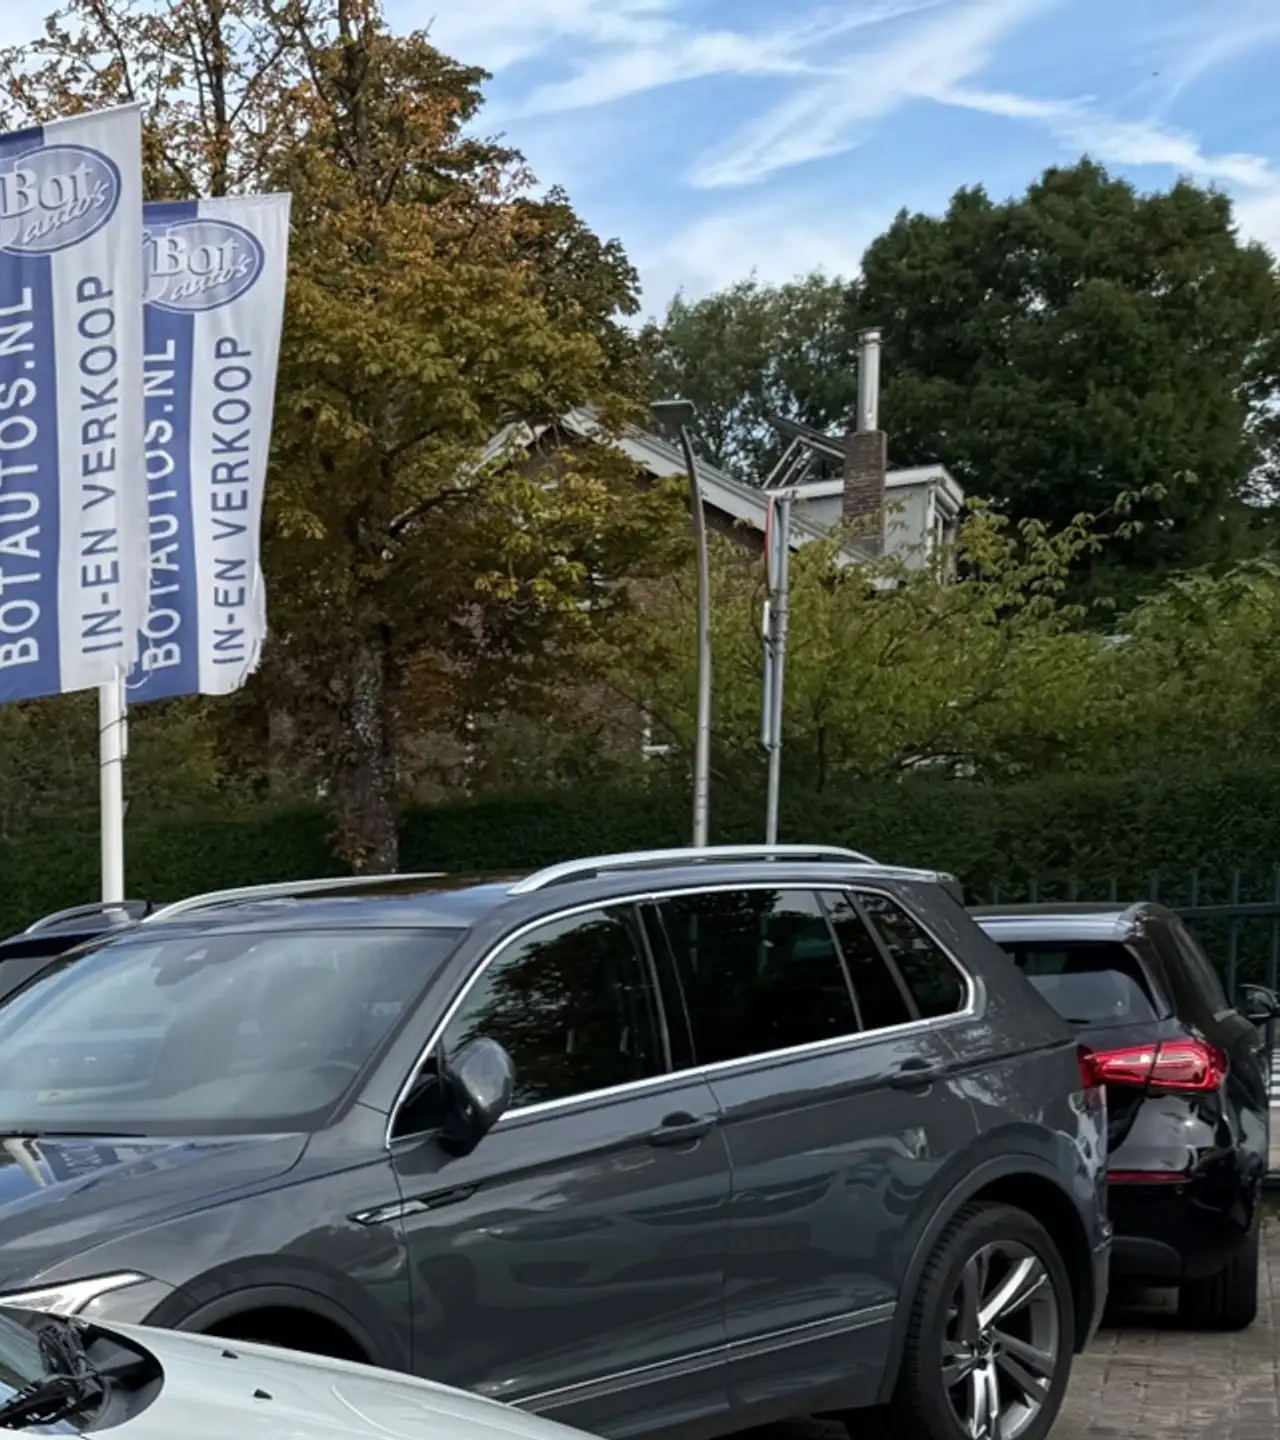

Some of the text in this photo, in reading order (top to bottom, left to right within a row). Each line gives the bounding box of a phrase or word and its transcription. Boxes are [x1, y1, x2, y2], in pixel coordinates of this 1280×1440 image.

[0, 161, 92, 219] Bot
[23, 180, 110, 244] auto's
[150, 234, 239, 278] Bot
[170, 254, 253, 301] auto's
[76, 275, 124, 655] IN-EN VERKOOP
[210, 335, 253, 666] IN-EN VERKOOP
